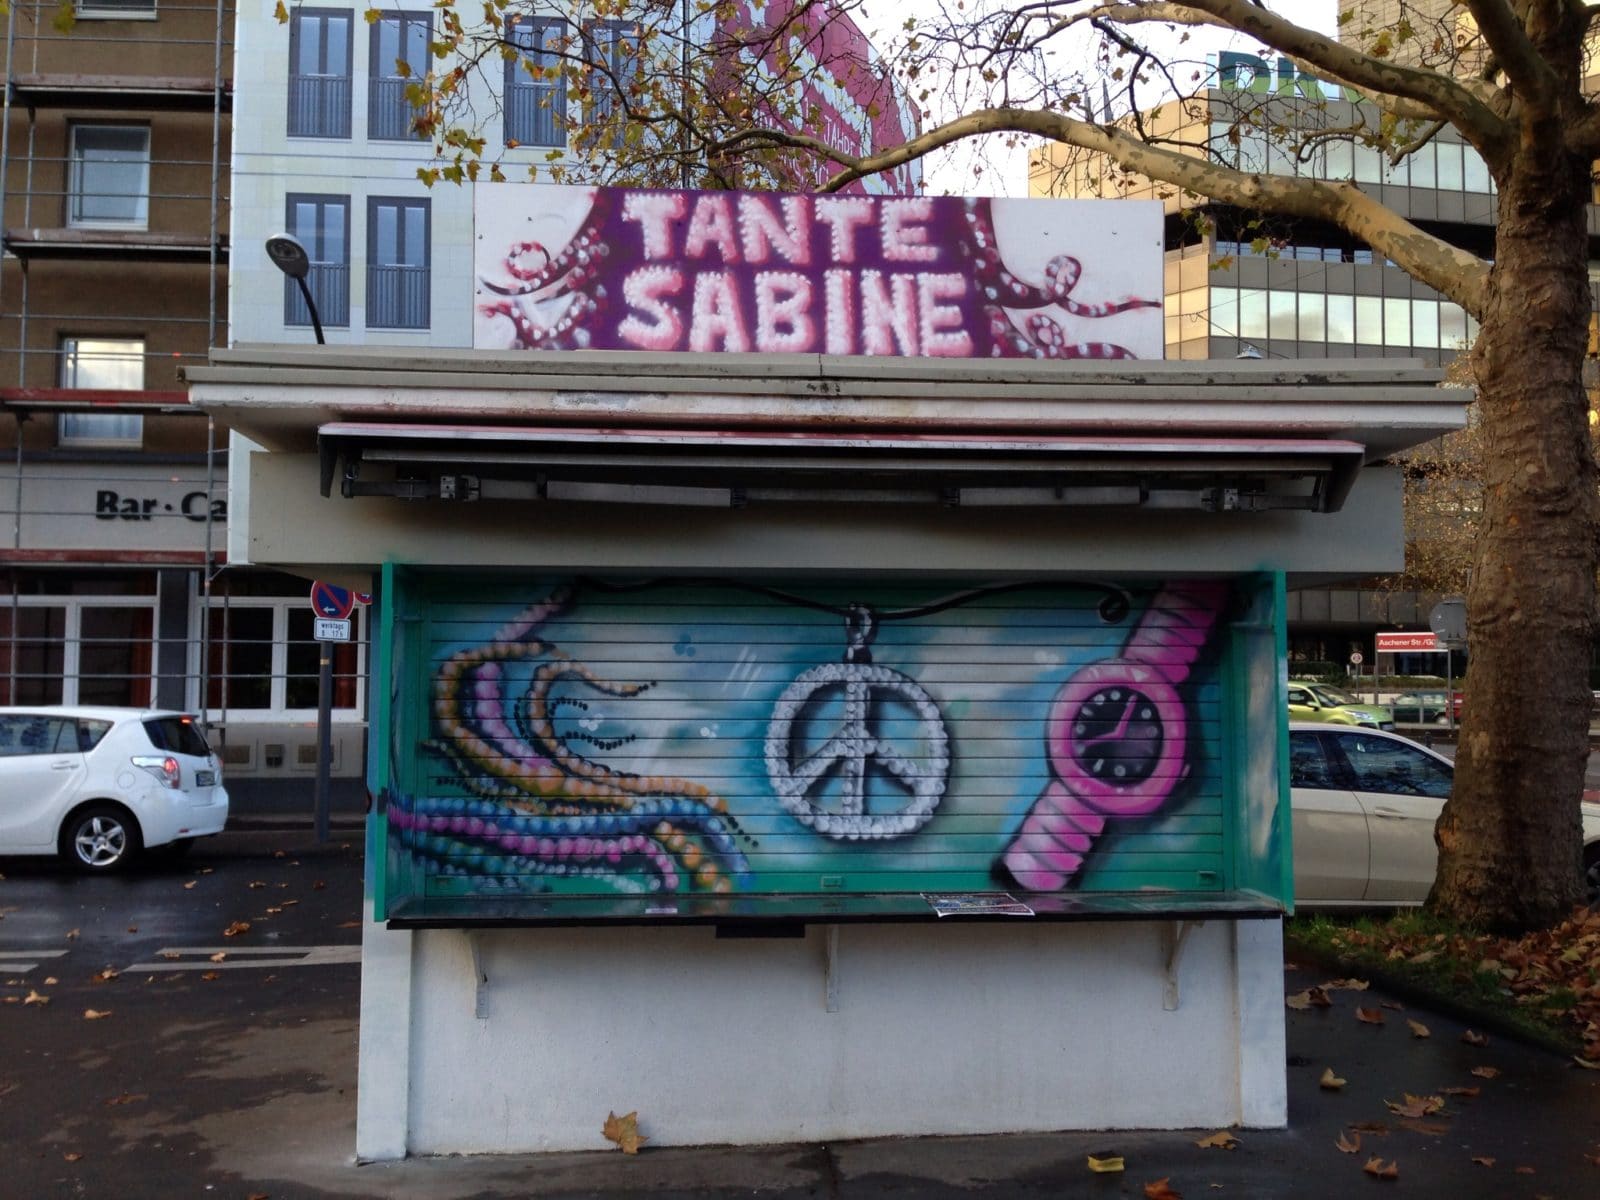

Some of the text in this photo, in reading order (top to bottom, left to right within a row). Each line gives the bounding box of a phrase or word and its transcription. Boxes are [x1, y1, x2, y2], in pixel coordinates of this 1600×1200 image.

[1218, 49, 1374, 105] DK
[622, 192, 939, 265] TANTE
[617, 265, 974, 357] SABINE
[96, 489, 157, 521] Bar
